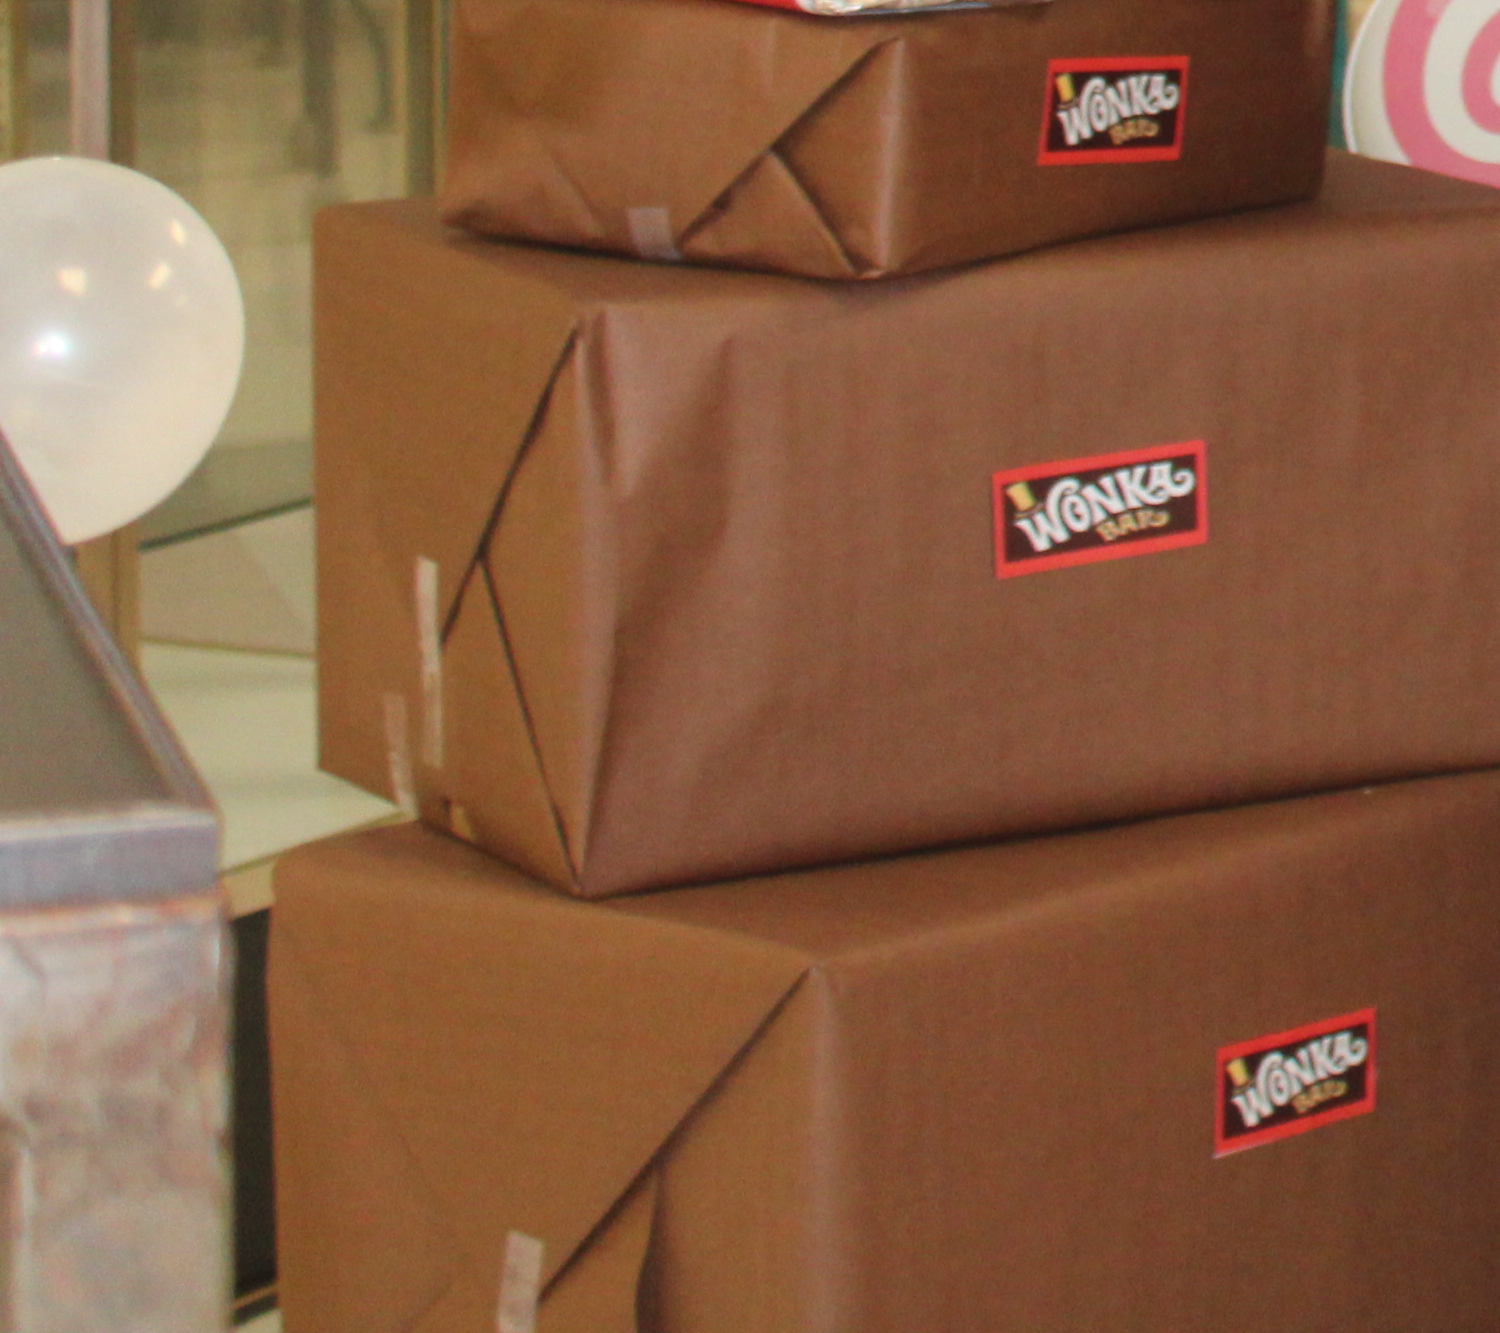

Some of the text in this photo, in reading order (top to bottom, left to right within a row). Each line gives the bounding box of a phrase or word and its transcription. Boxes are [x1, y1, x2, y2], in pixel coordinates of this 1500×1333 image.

[1057, 72, 1180, 146] WONKA
[1014, 460, 1197, 552] WONKA
[1231, 1031, 1369, 1128] WONKA
